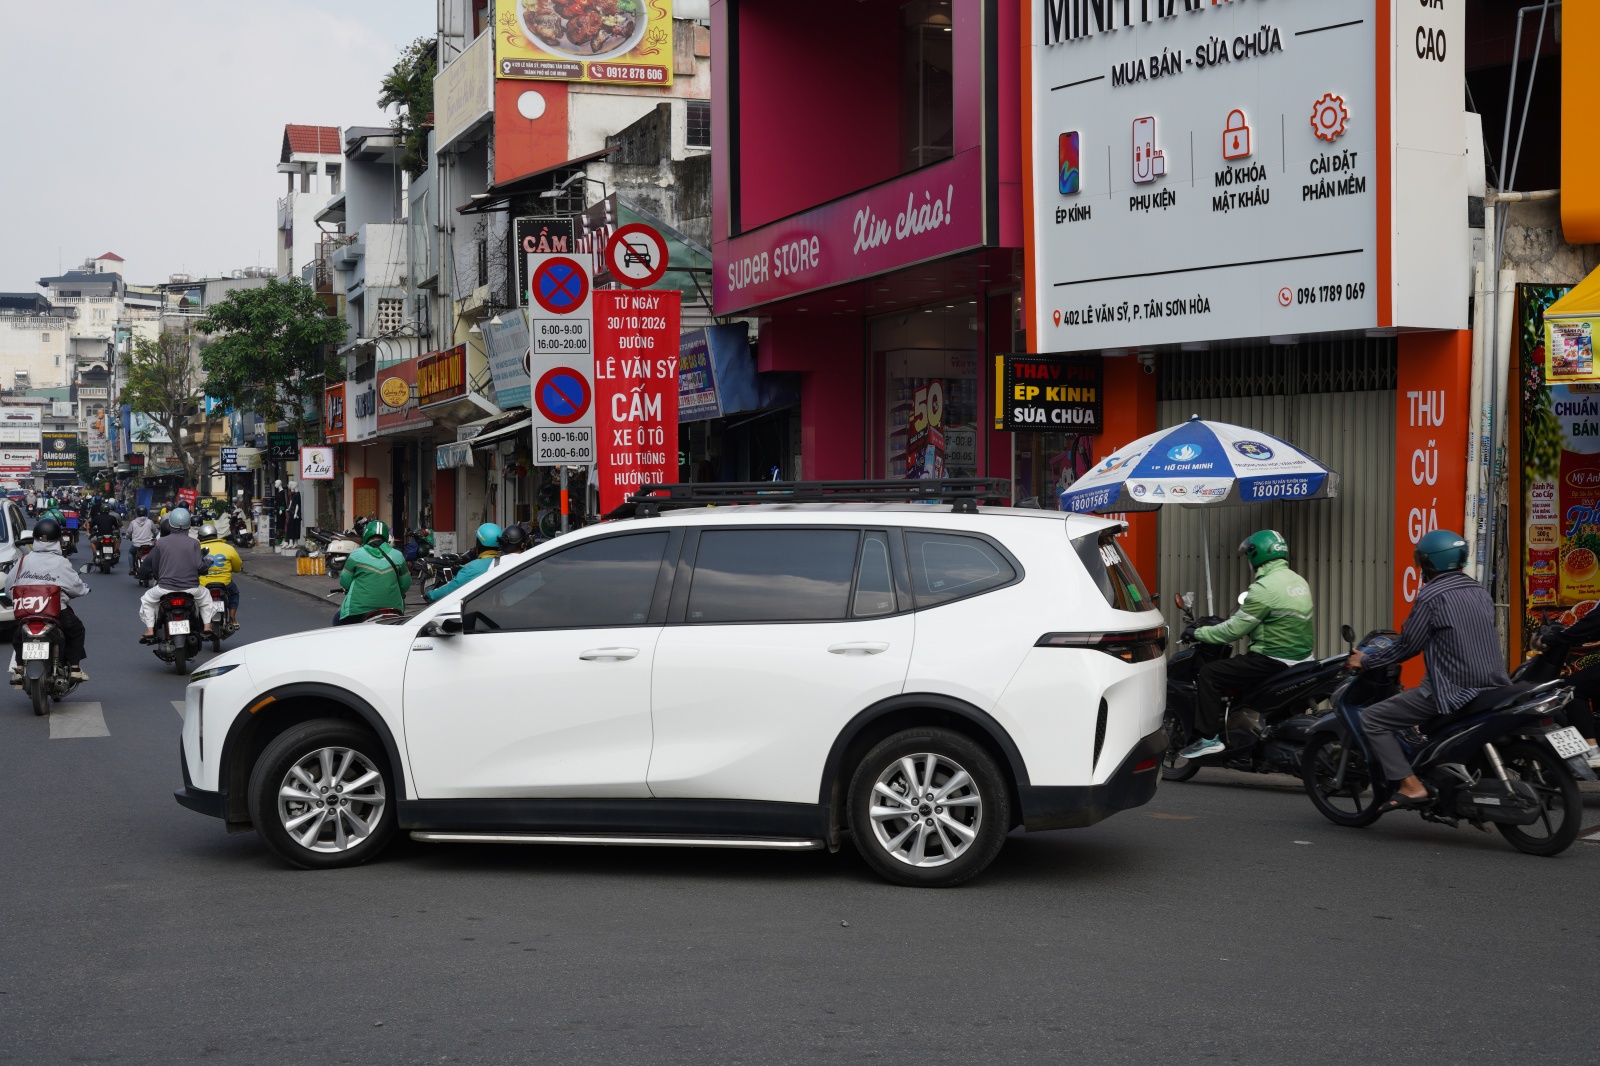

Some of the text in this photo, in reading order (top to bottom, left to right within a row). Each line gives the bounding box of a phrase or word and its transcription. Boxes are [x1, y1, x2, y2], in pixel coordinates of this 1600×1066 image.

[1416, 26, 1446, 62] CAO
[1112, 59, 1147, 86] MUA
[1150, 47, 1182, 77] BÁN
[1196, 36, 1230, 68] SỬA
[1233, 24, 1283, 60] CHỮA
[607, 67, 662, 80] 0912 878 606
[1310, 150, 1357, 175] CÀI ĐẶT
[1215, 162, 1266, 187] MỞ KHÓA
[1303, 174, 1366, 201] PHẦN MỀM
[1130, 188, 1175, 213] PHỤ KIỆN
[1212, 184, 1270, 213] MẬT KHẨU
[853, 184, 953, 255] Xin chào!
[1056, 203, 1091, 224] ÉP KÍNH
[523, 226, 568, 252] CẦM
[615, 295, 659, 310] TỪ NGÀY
[1297, 282, 1365, 305] 096 1789 069
[1064, 294, 1210, 326] 402 LÊ VĂN SỸ, P. TÂN SƠN HÒA
[542, 325, 582, 335] 6:00-9:00
[607, 317, 666, 330] 30/10/2026
[538, 339, 587, 349] 16:00-20:00
[619, 334, 654, 349] ĐƯỜNG
[596, 356, 678, 379] LÊ VĂN SỸ
[1014, 363, 1059, 379] THAY
[612, 383, 662, 422] CẤM
[1014, 382, 1096, 403] ÉP KÍNH
[1014, 404, 1095, 424] SỬA CHỮA
[1407, 391, 1445, 427] THU
[1555, 396, 1599, 416] CHUẨN
[541, 432, 588, 442] 9:00-16:00
[613, 426, 664, 446] XE Ô TÔ
[1573, 419, 1599, 436] BÁN
[541, 448, 590, 458] 20:00-6:00
[611, 451, 665, 466] LƯU THÔNG
[1411, 439, 1438, 485] CŨ
[304, 465, 312, 473] A
[614, 471, 664, 485] HƯỚNG TỪ
[1572, 473, 1585, 484] Mỹ
[1253, 483, 1308, 498] 18001568
[1543, 490, 1553, 499] Cấp
[1071, 493, 1108, 511] 18001568
[1408, 498, 1439, 544] GIÁ
[1287, 585, 1309, 597] Grab
